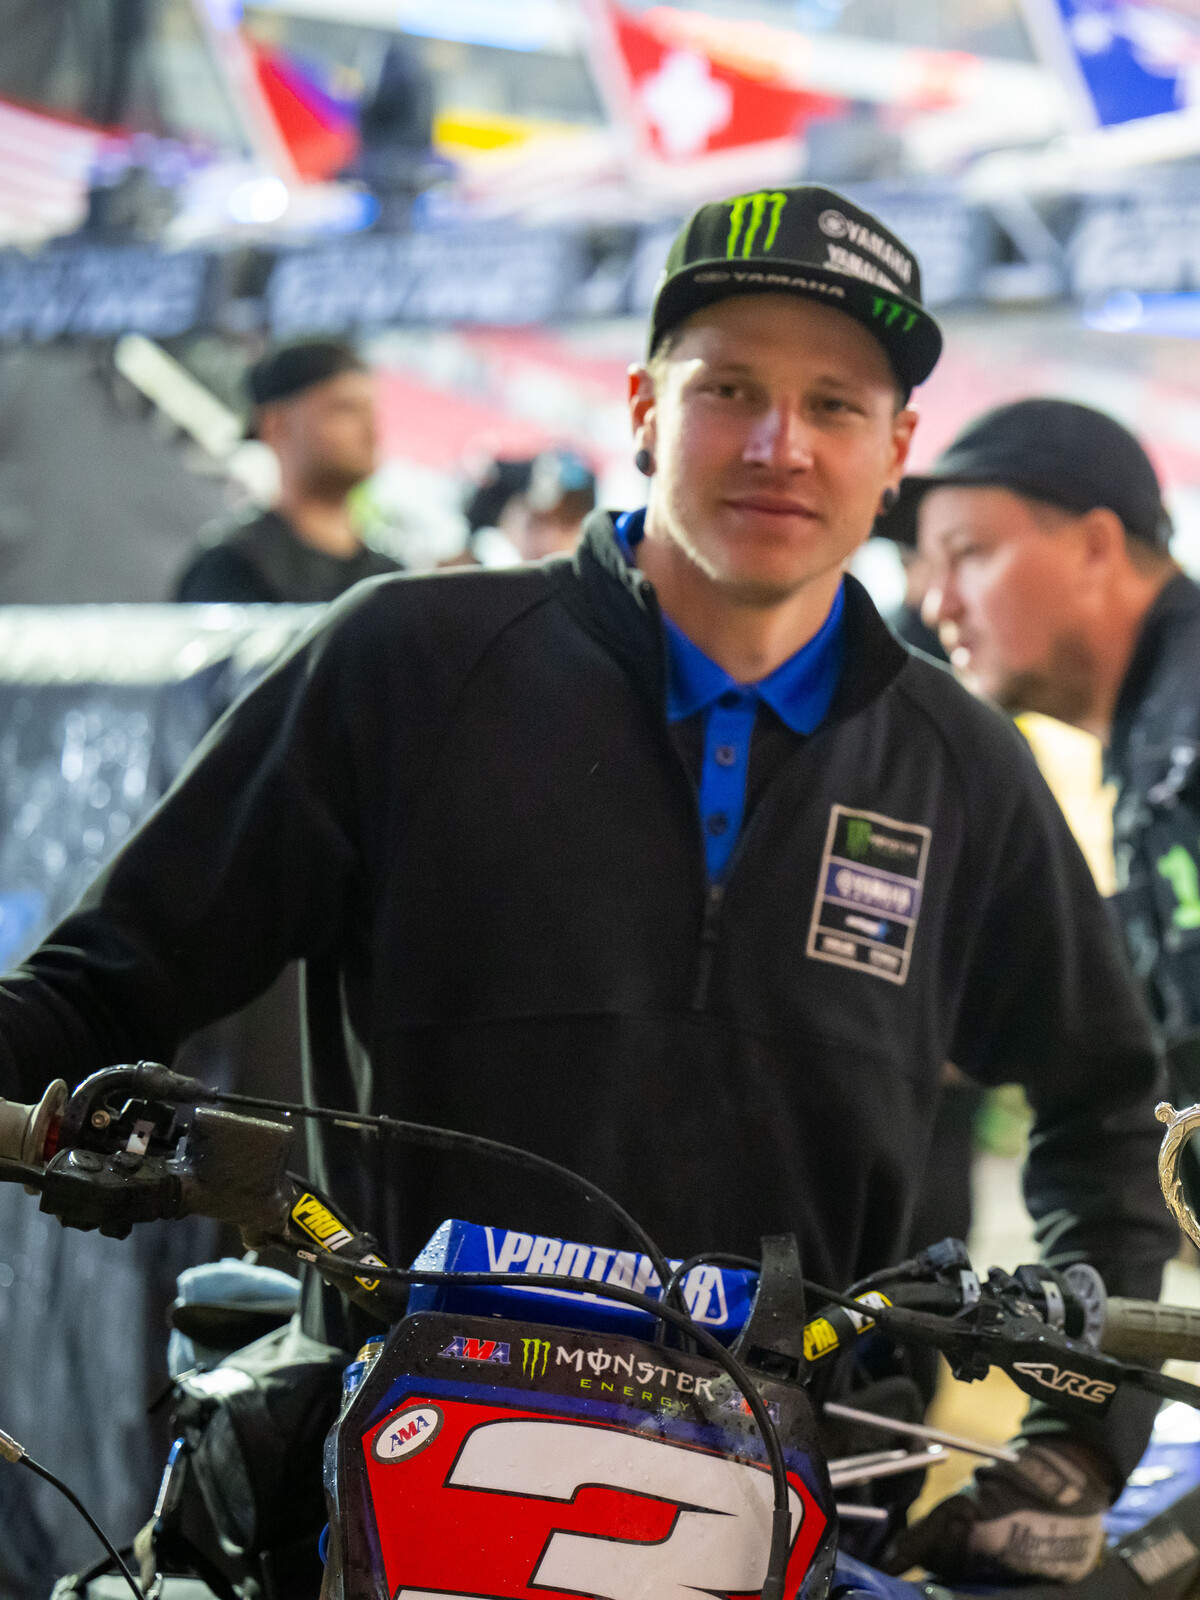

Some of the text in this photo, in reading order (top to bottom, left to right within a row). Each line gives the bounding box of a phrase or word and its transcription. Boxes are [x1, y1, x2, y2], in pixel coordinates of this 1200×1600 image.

[432, 1336, 512, 1365] AMA
[555, 1345, 716, 1402] MONSTER
[1013, 1362, 1116, 1403] ARC
[580, 1378, 690, 1412] ENERGY
[389, 1415, 430, 1453] AMA
[396, 1417, 805, 1600] 3
